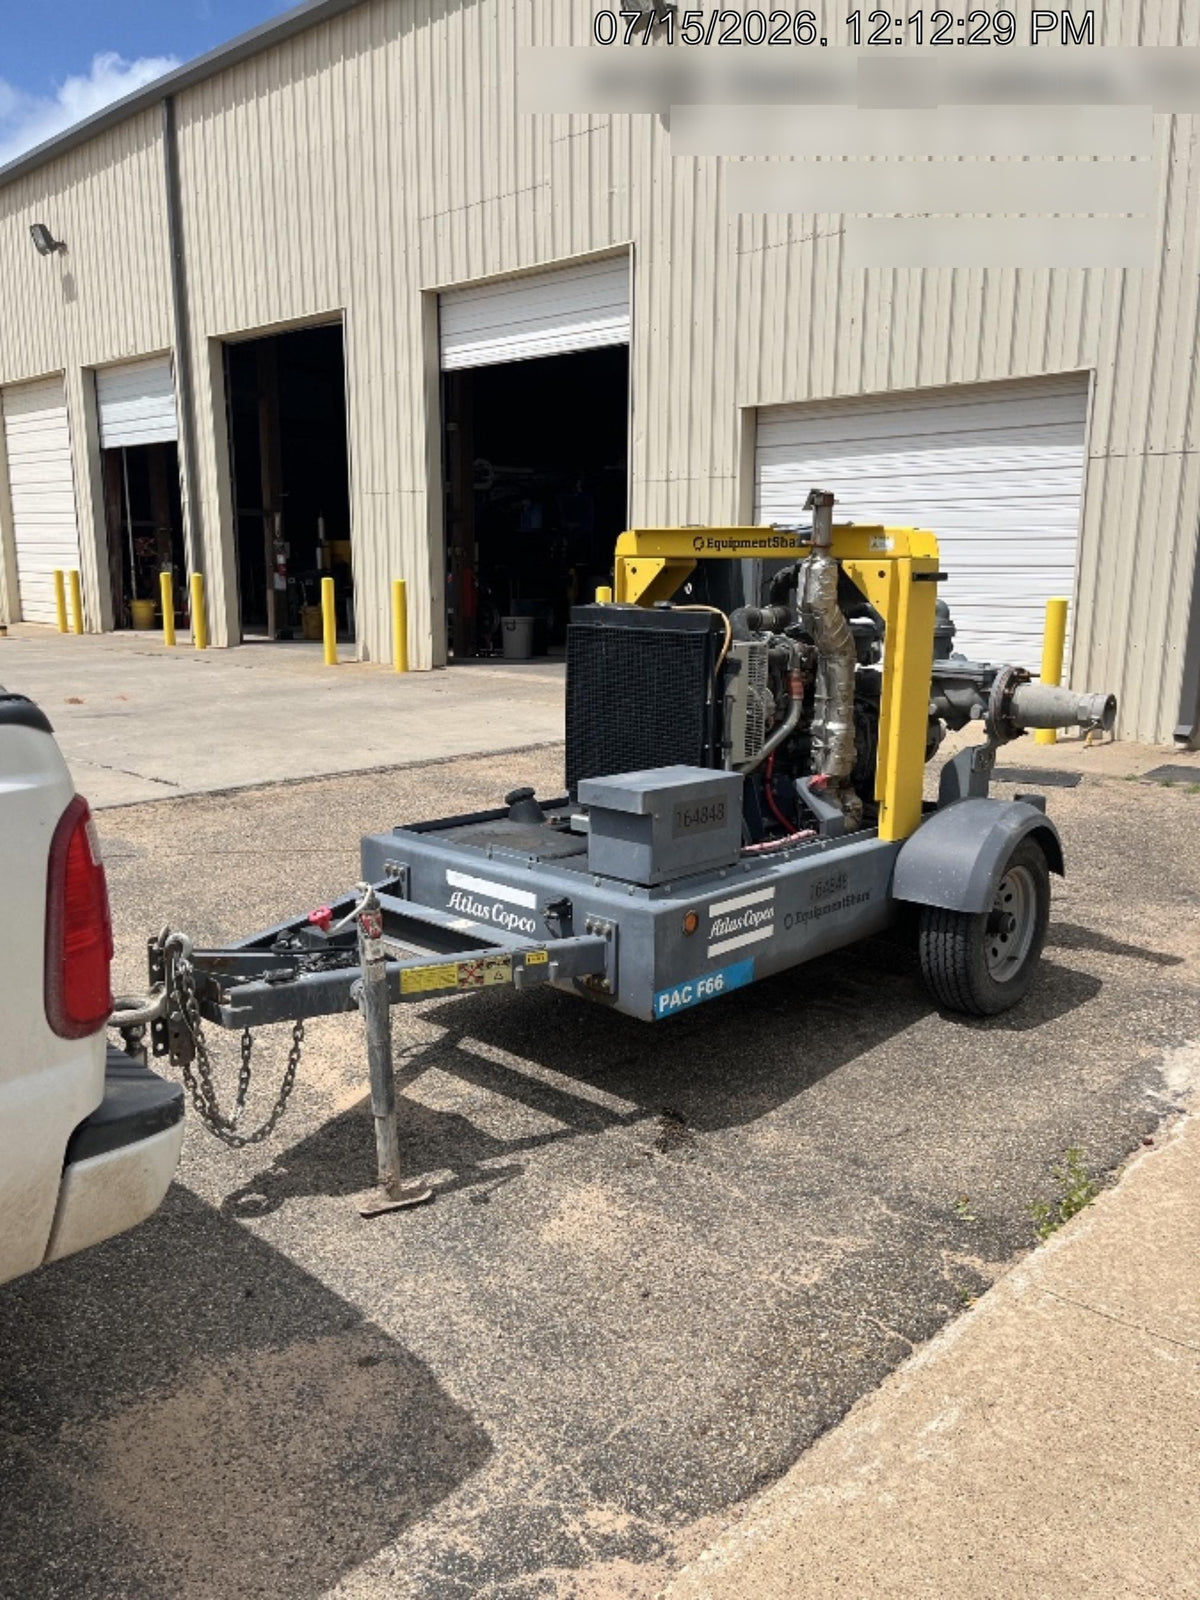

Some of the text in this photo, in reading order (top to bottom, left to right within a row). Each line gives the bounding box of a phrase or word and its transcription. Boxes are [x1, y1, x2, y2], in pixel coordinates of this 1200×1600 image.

[706, 537, 797, 551] EquipmentSha
[446, 891, 536, 933] Atlas Copco
[708, 906, 775, 939] Atlas Copco
[659, 973, 724, 1012] PAC F66
